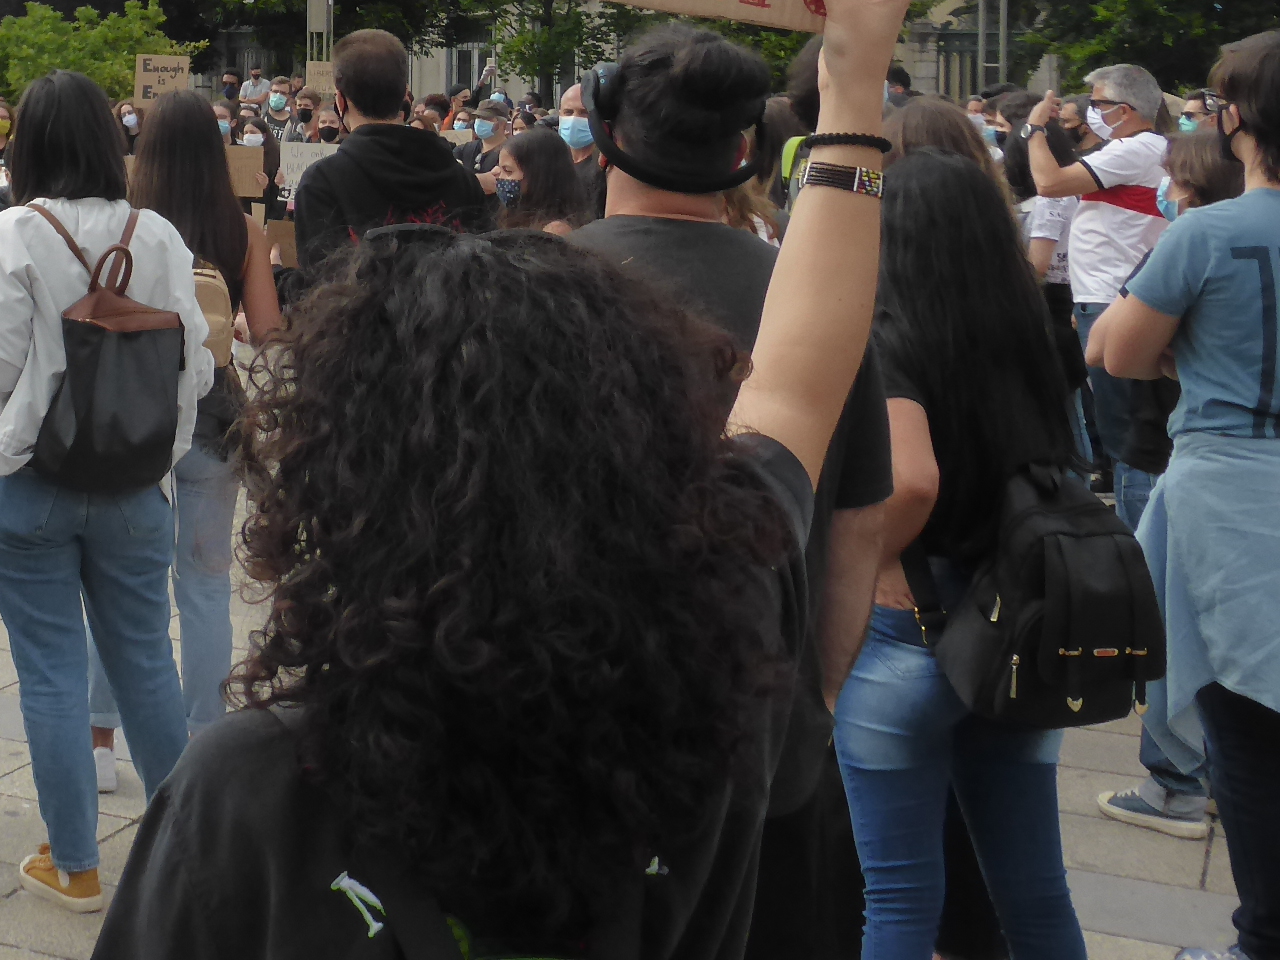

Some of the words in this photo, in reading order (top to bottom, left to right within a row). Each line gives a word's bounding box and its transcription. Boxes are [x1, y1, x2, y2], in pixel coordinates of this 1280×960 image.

[142, 58, 184, 79] Enough
[157, 76, 166, 86] is
[286, 161, 308, 176] BLAC
